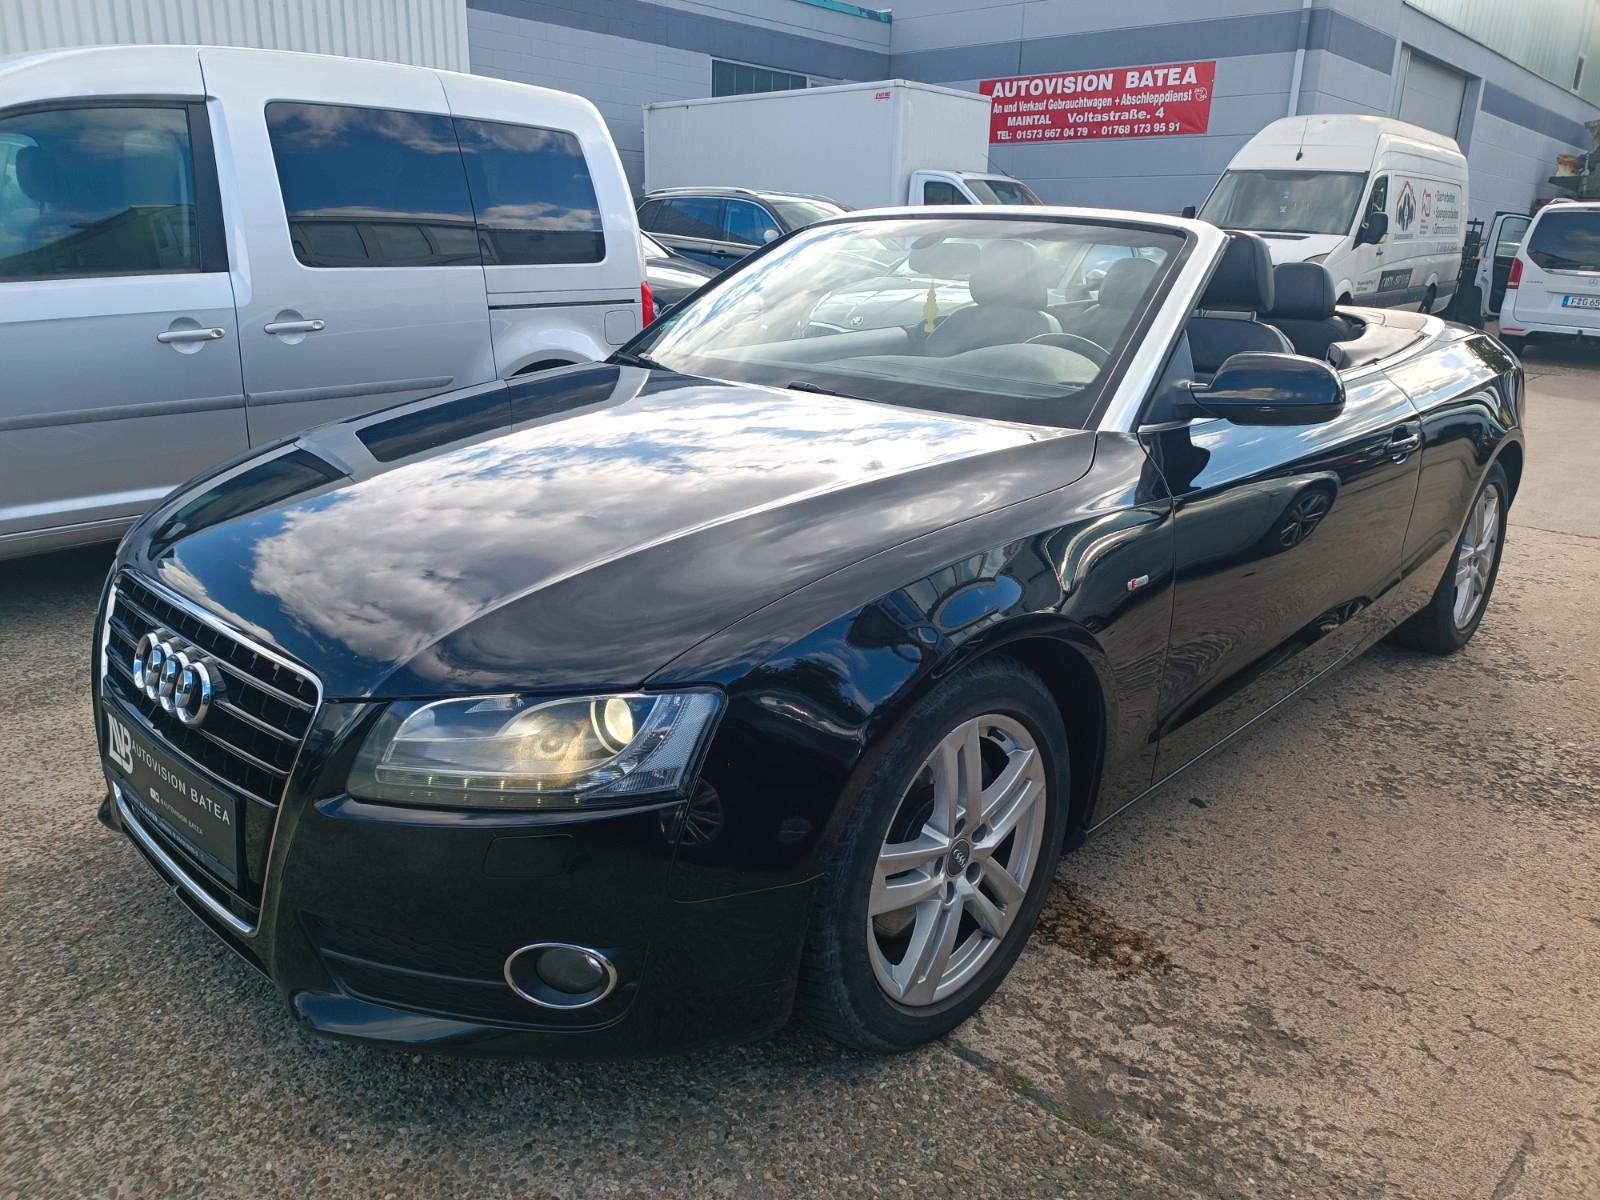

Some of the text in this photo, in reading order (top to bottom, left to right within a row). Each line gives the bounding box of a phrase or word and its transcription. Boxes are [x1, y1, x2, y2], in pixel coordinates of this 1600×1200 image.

[992, 67, 1197, 98] AUTOVISION BATEA
[993, 103, 1002, 114] An
[1004, 102, 1016, 113] und
[1019, 99, 1046, 111] Verkauf
[1048, 97, 1112, 109] Gebrauchtwagen
[1007, 114, 1051, 126] MAINTAL
[1155, 107, 1165, 118] 4
[1016, 129, 1042, 139] 01573
[1044, 128, 1060, 138] 667
[1063, 128, 1074, 137] 04
[1077, 127, 1088, 136] 79
[1101, 125, 1130, 135] 01768
[1133, 124, 1150, 133] 173
[1153, 123, 1165, 132] 95
[1168, 122, 1180, 131] 91
[131, 742, 186, 796] AUTOVISION
[190, 788, 230, 825] BATEA
